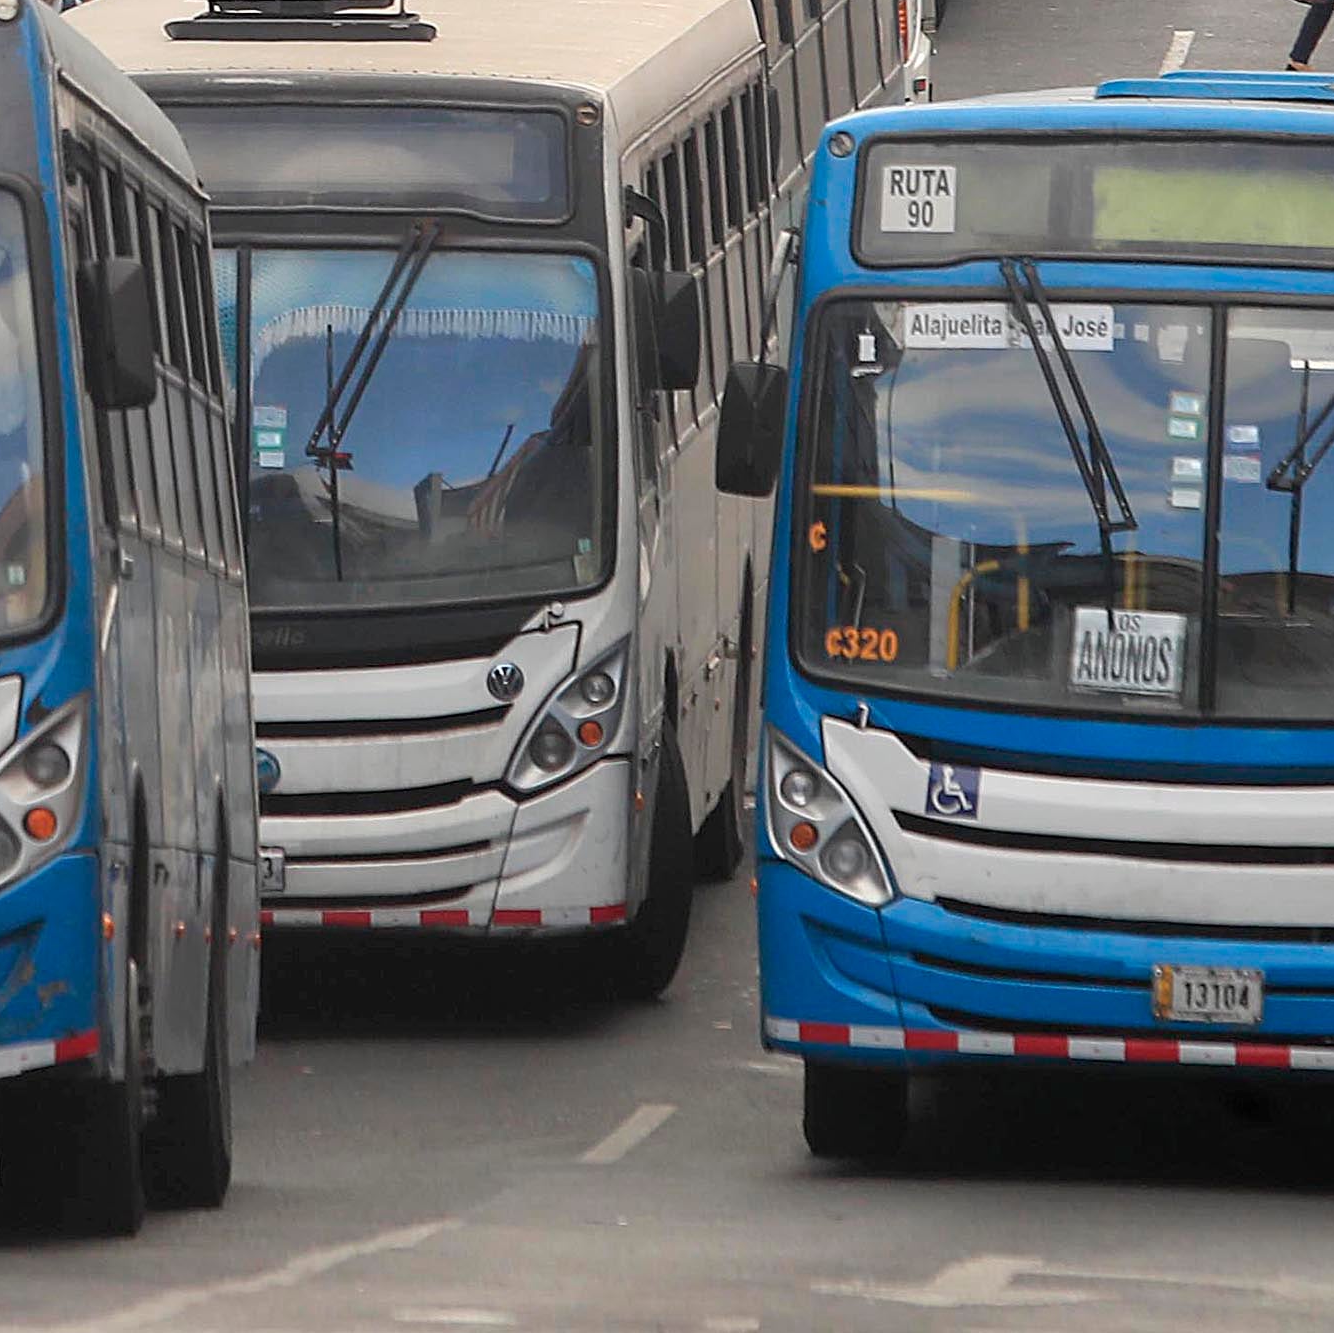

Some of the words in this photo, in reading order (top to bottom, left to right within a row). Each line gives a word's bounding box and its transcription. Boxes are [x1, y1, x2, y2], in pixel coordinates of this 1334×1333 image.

[888, 168, 952, 198] RUTA
[906, 200, 935, 229] 90
[910, 312, 1004, 338] Alajuelita
[1063, 314, 1109, 339] José
[1077, 630, 1172, 684] ANONOS
[1184, 981, 1250, 1011] 13104
